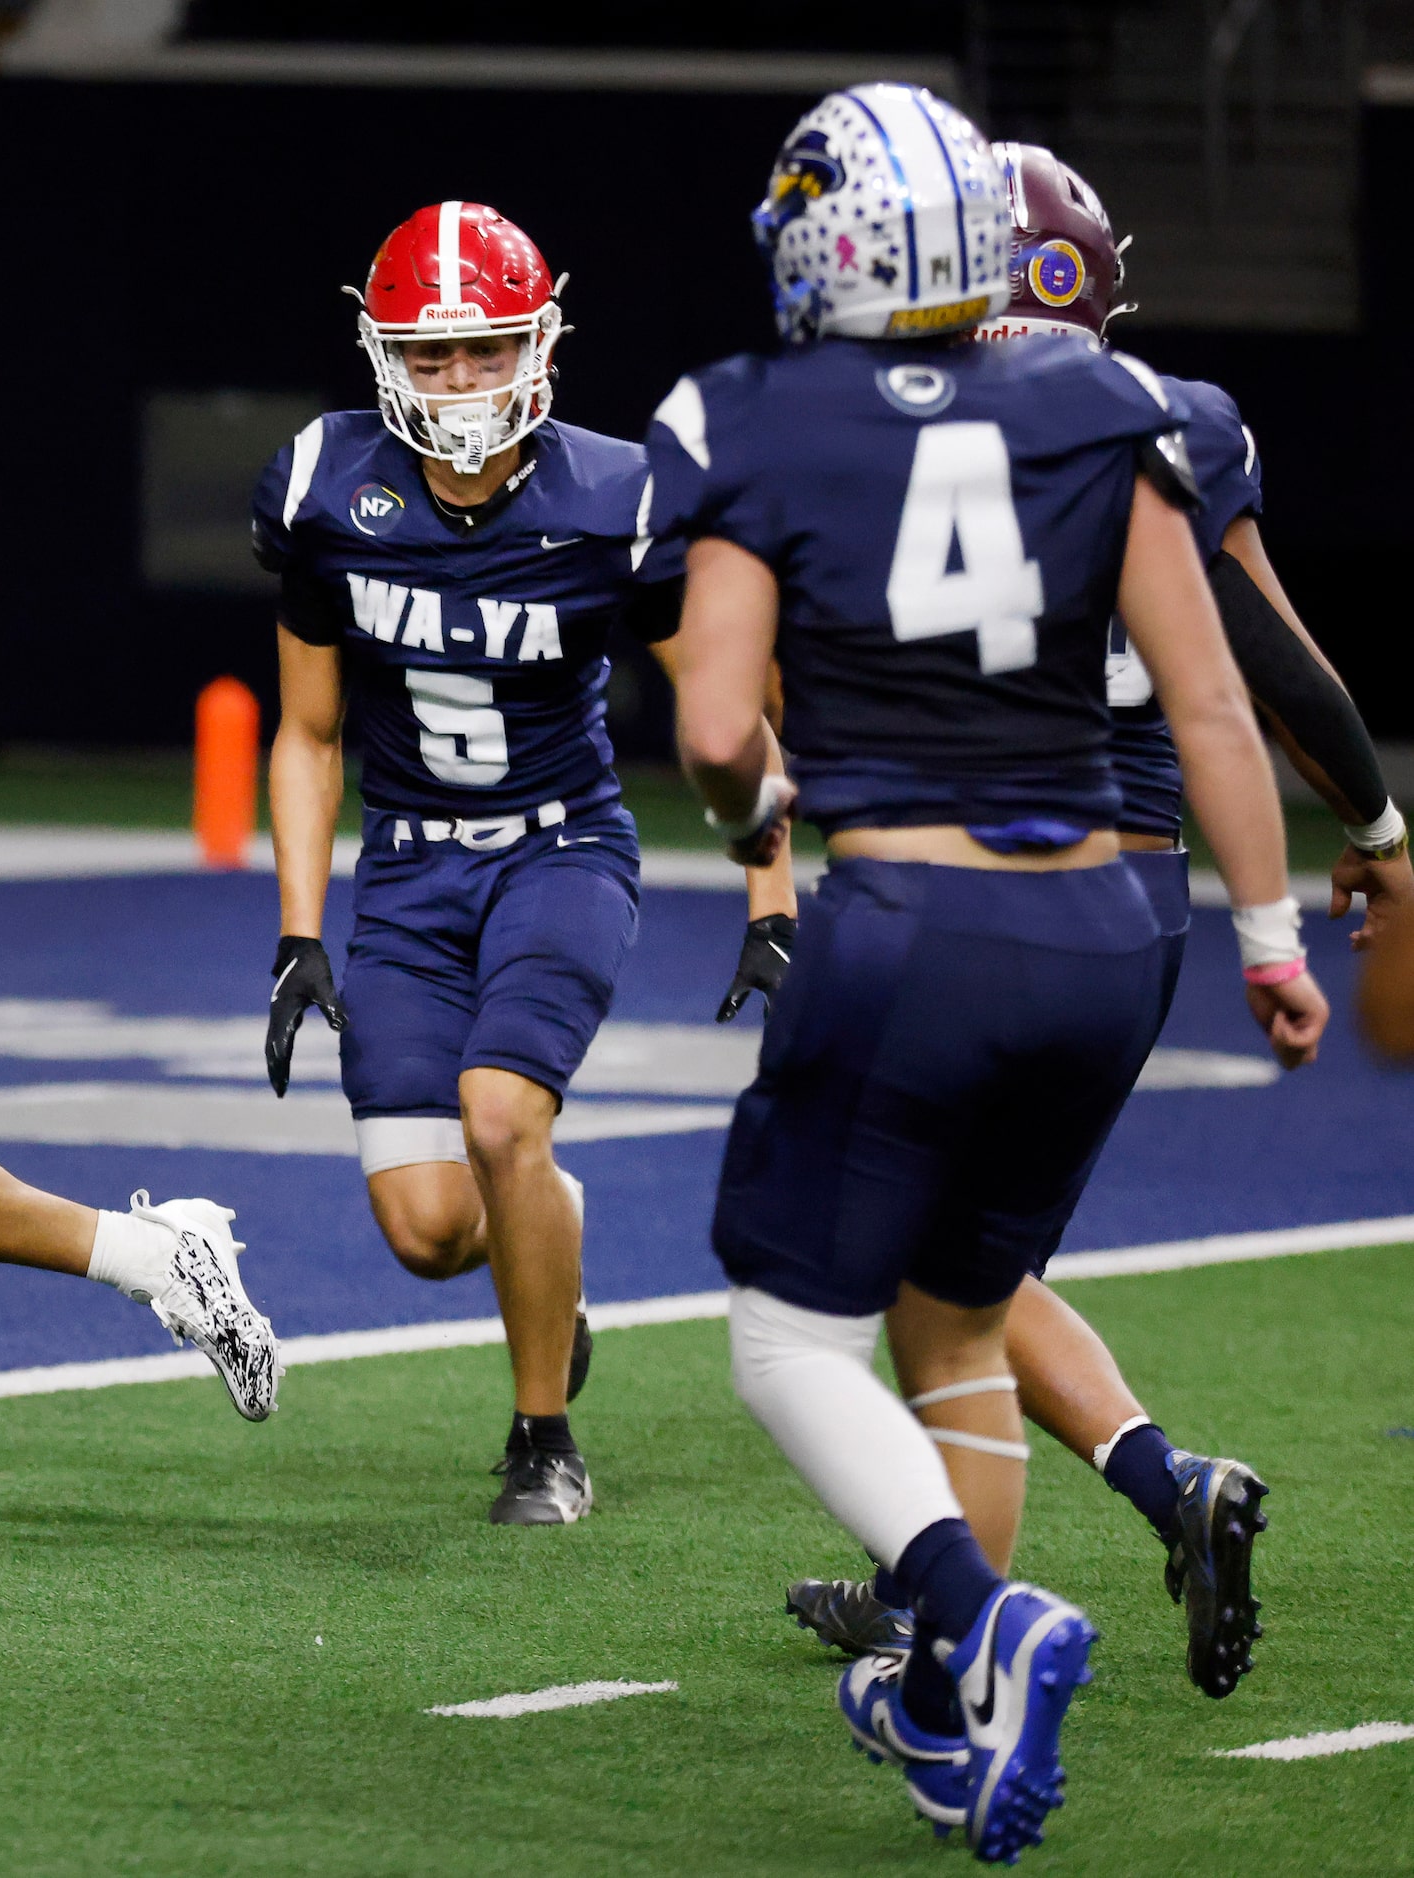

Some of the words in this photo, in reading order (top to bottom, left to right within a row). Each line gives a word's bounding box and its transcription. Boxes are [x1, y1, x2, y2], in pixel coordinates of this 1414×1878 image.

[426, 307, 477, 320] Riddell
[359, 496, 394, 518] N7
[885, 419, 1045, 676] 4
[346, 571, 564, 661] WA-YA
[405, 668, 510, 786] 5
